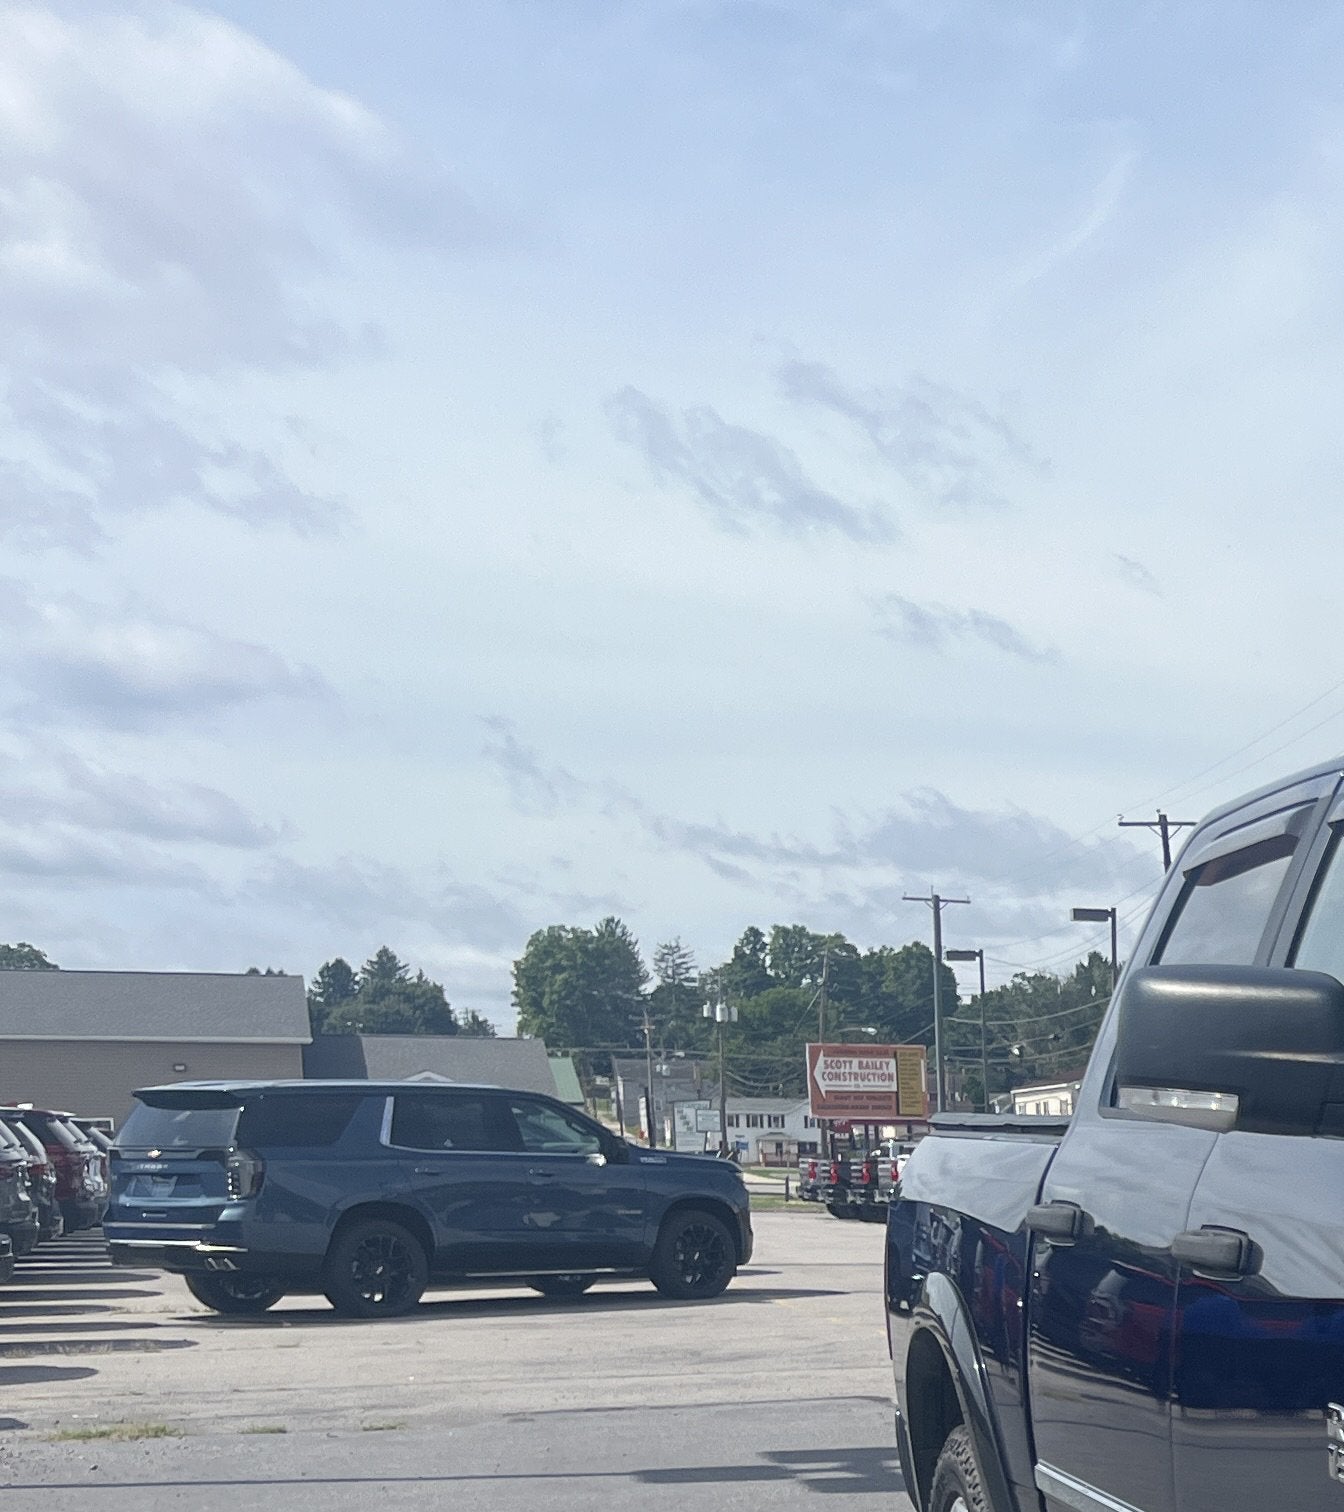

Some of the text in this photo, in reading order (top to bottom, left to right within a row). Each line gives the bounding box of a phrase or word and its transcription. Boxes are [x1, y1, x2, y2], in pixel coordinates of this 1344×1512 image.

[823, 1059, 890, 1070] SCOTT BAILEY
[821, 1071, 894, 1082] CONSTRUCTION
